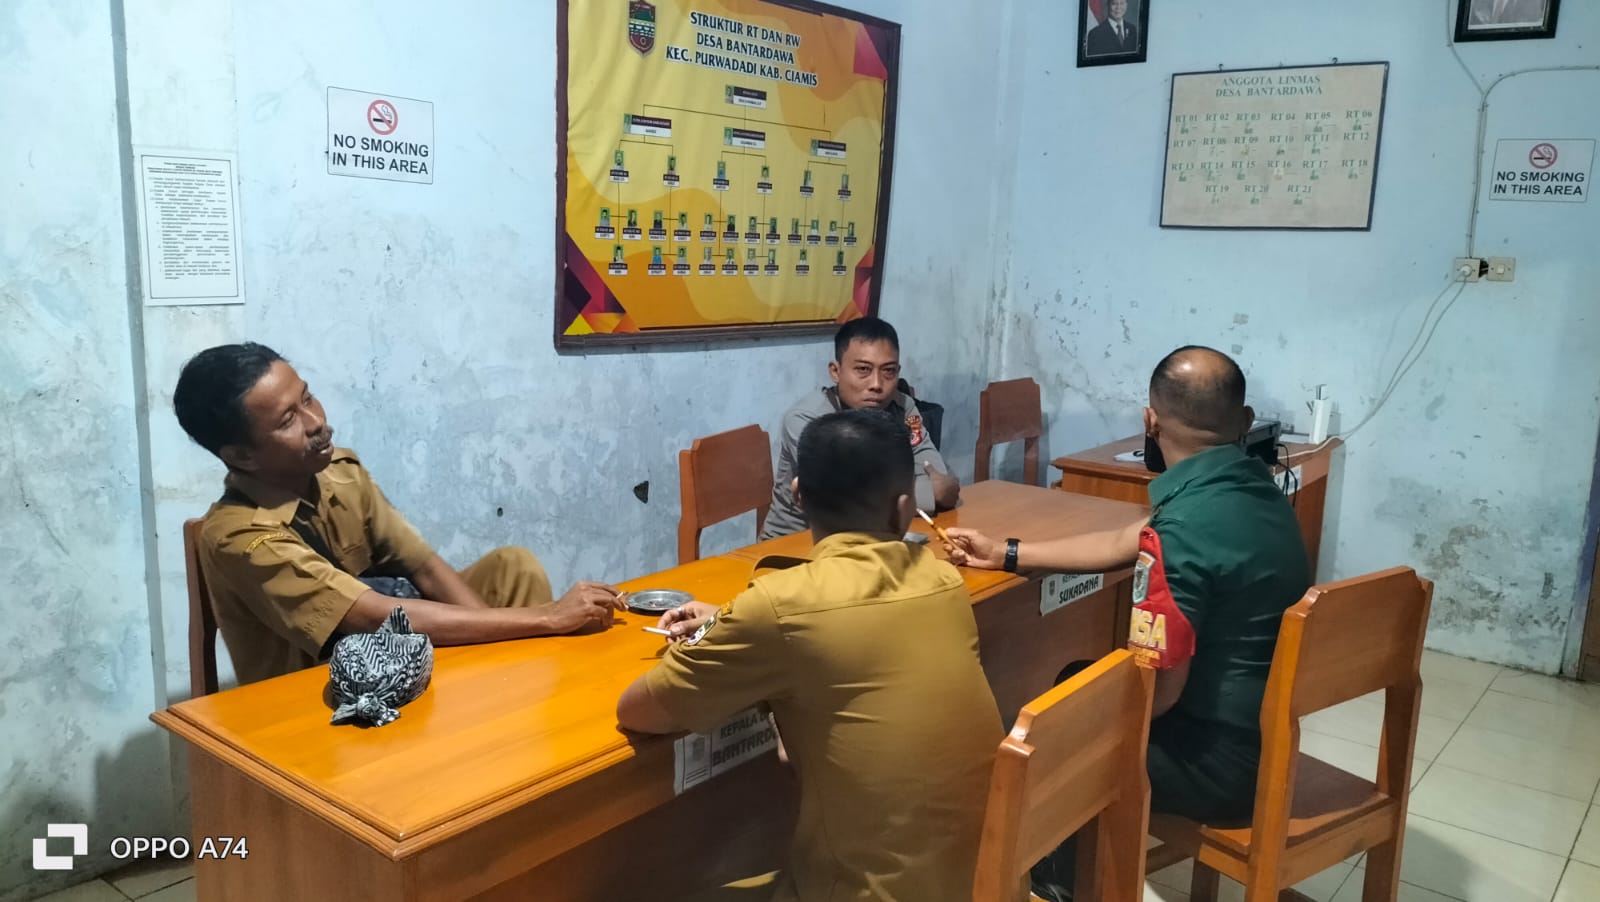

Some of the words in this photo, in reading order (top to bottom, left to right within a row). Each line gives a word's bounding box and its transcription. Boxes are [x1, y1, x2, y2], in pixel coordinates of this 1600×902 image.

[690, 11, 743, 35] STRUKTUR
[746, 25, 759, 38] RT
[761, 28, 782, 44] DAN
[785, 34, 800, 47] RW
[697, 32, 723, 49] DESA
[726, 38, 794, 65] BANTARDAWA
[666, 45, 692, 62] KEC.
[695, 51, 757, 75] PURWADADI
[759, 65, 782, 80] KAB.
[785, 69, 818, 86] CIAMIS
[1222, 75, 1273, 86] ANGGOTA
[1279, 75, 1321, 85] LINMAS
[1215, 87, 1241, 97] DESA
[1247, 86, 1323, 96] BANTARDAWA
[1175, 115, 1186, 123] RT
[1189, 114, 1198, 122] 01
[1206, 113, 1217, 121] RT
[1236, 113, 1248, 121] RT
[1271, 112, 1283, 121] RT
[1285, 112, 1295, 120] 04
[1305, 112, 1319, 120] RT
[1320, 112, 1331, 120] 05
[1345, 110, 1359, 119] RT
[1203, 137, 1214, 145] RT
[1234, 136, 1246, 144] RT
[1248, 136, 1258, 144] 09
[1269, 135, 1281, 143] RT
[1285, 135, 1294, 143] 10
[1321, 134, 1329, 142] 11
[1343, 132, 1356, 141] RT
[1360, 132, 1369, 140] 12
[333, 133, 356, 149] NO
[360, 137, 429, 157] SMOKING
[1173, 139, 1185, 148] RT
[1187, 139, 1196, 147] 07
[332, 152, 347, 166] IN
[352, 154, 385, 170] THIS
[389, 158, 428, 175] AREA
[1246, 160, 1256, 168] 15
[1267, 160, 1280, 168] RT
[1283, 160, 1292, 168] 16
[1303, 160, 1317, 168] RT
[1319, 160, 1328, 168] 17
[1342, 159, 1354, 168] RT
[1496, 171, 1516, 181] NO
[1520, 171, 1585, 182] SMOKING
[1205, 185, 1217, 193] RT
[1244, 185, 1256, 193] RT
[1287, 184, 1300, 193] RT
[1302, 185, 1312, 193] 21
[1493, 184, 1507, 194] IN
[1511, 184, 1541, 195] THIS
[1543, 185, 1583, 196] AREA
[1059, 575, 1099, 604] SUKADANA
[720, 713, 757, 739] KEPALA
